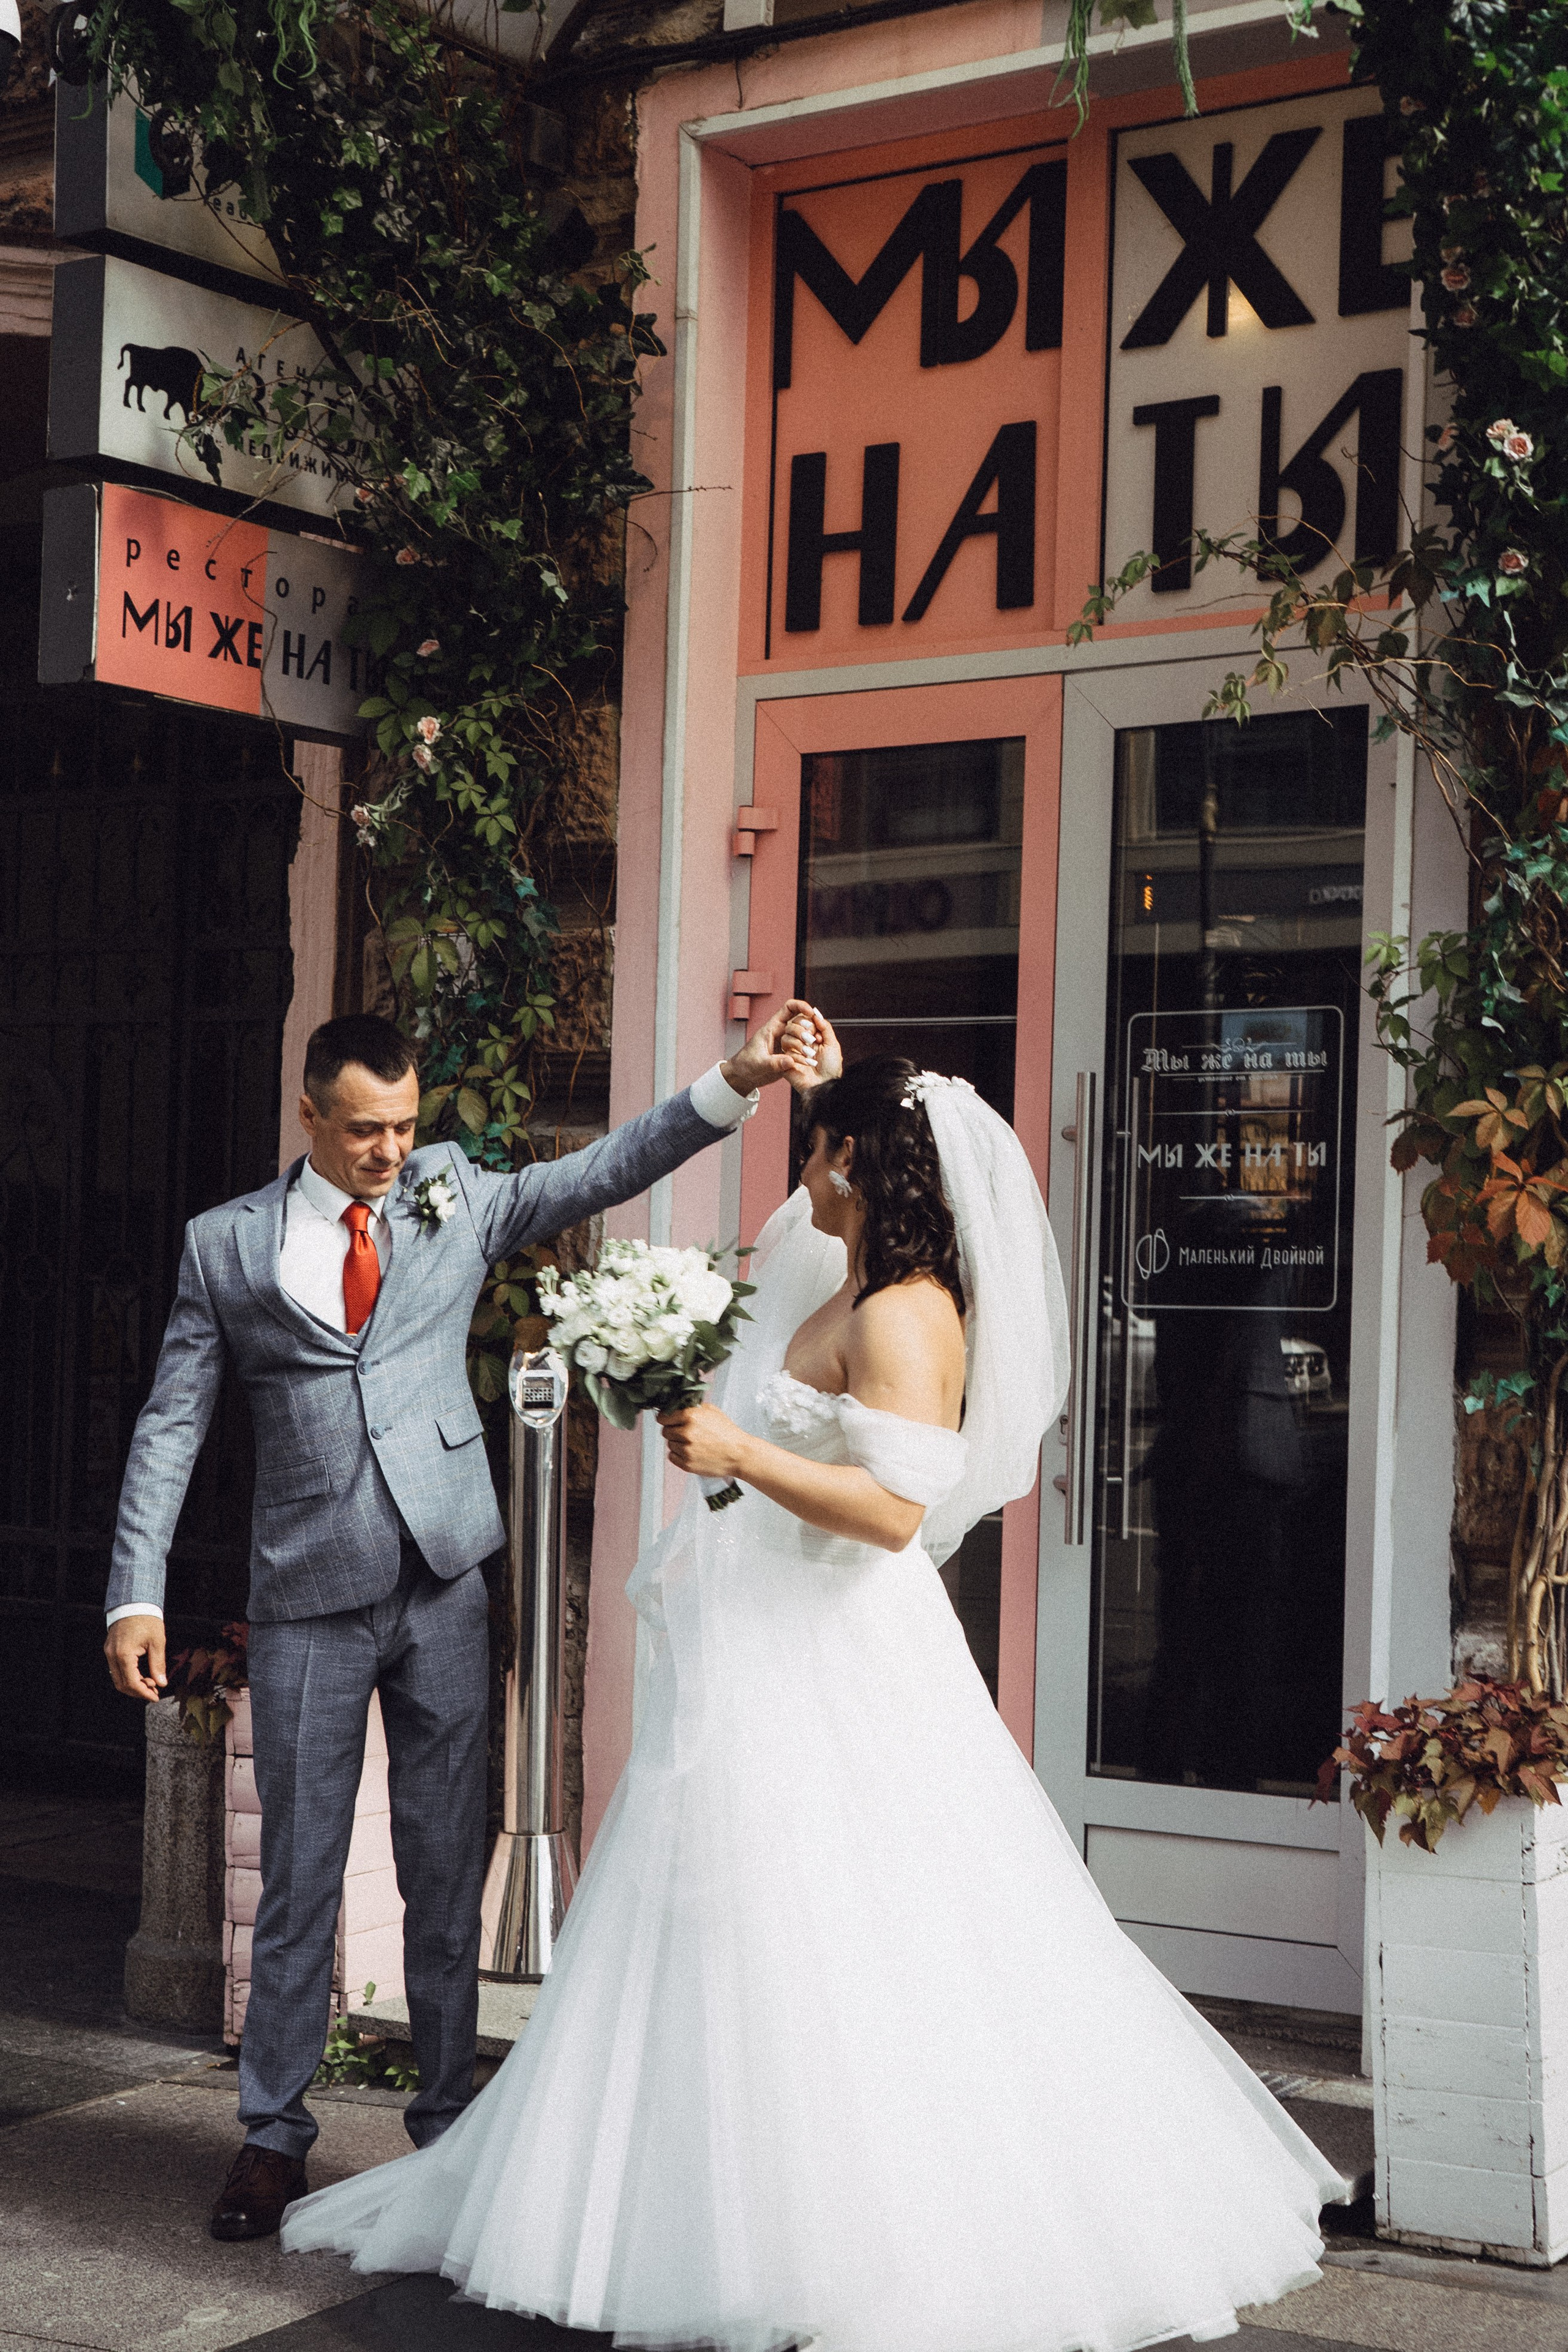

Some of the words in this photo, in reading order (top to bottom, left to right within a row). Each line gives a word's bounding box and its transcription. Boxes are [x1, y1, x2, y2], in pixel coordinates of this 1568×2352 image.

[777, 159, 1068, 390] МЫ
[1119, 113, 1416, 350] ЖЕ
[785, 420, 1037, 633] НА
[1133, 367, 1403, 594] ТЫ
[126, 538, 360, 614] рестора
[122, 590, 193, 654] МЫ
[208, 611, 263, 669] ЖЕ
[281, 630, 332, 686] НА
[1138, 1144, 1183, 1168] МЫ
[1194, 1143, 1232, 1168] ЖЕ
[1245, 1143, 1281, 1167] НА
[1294, 1142, 1326, 1167] ТЫ
